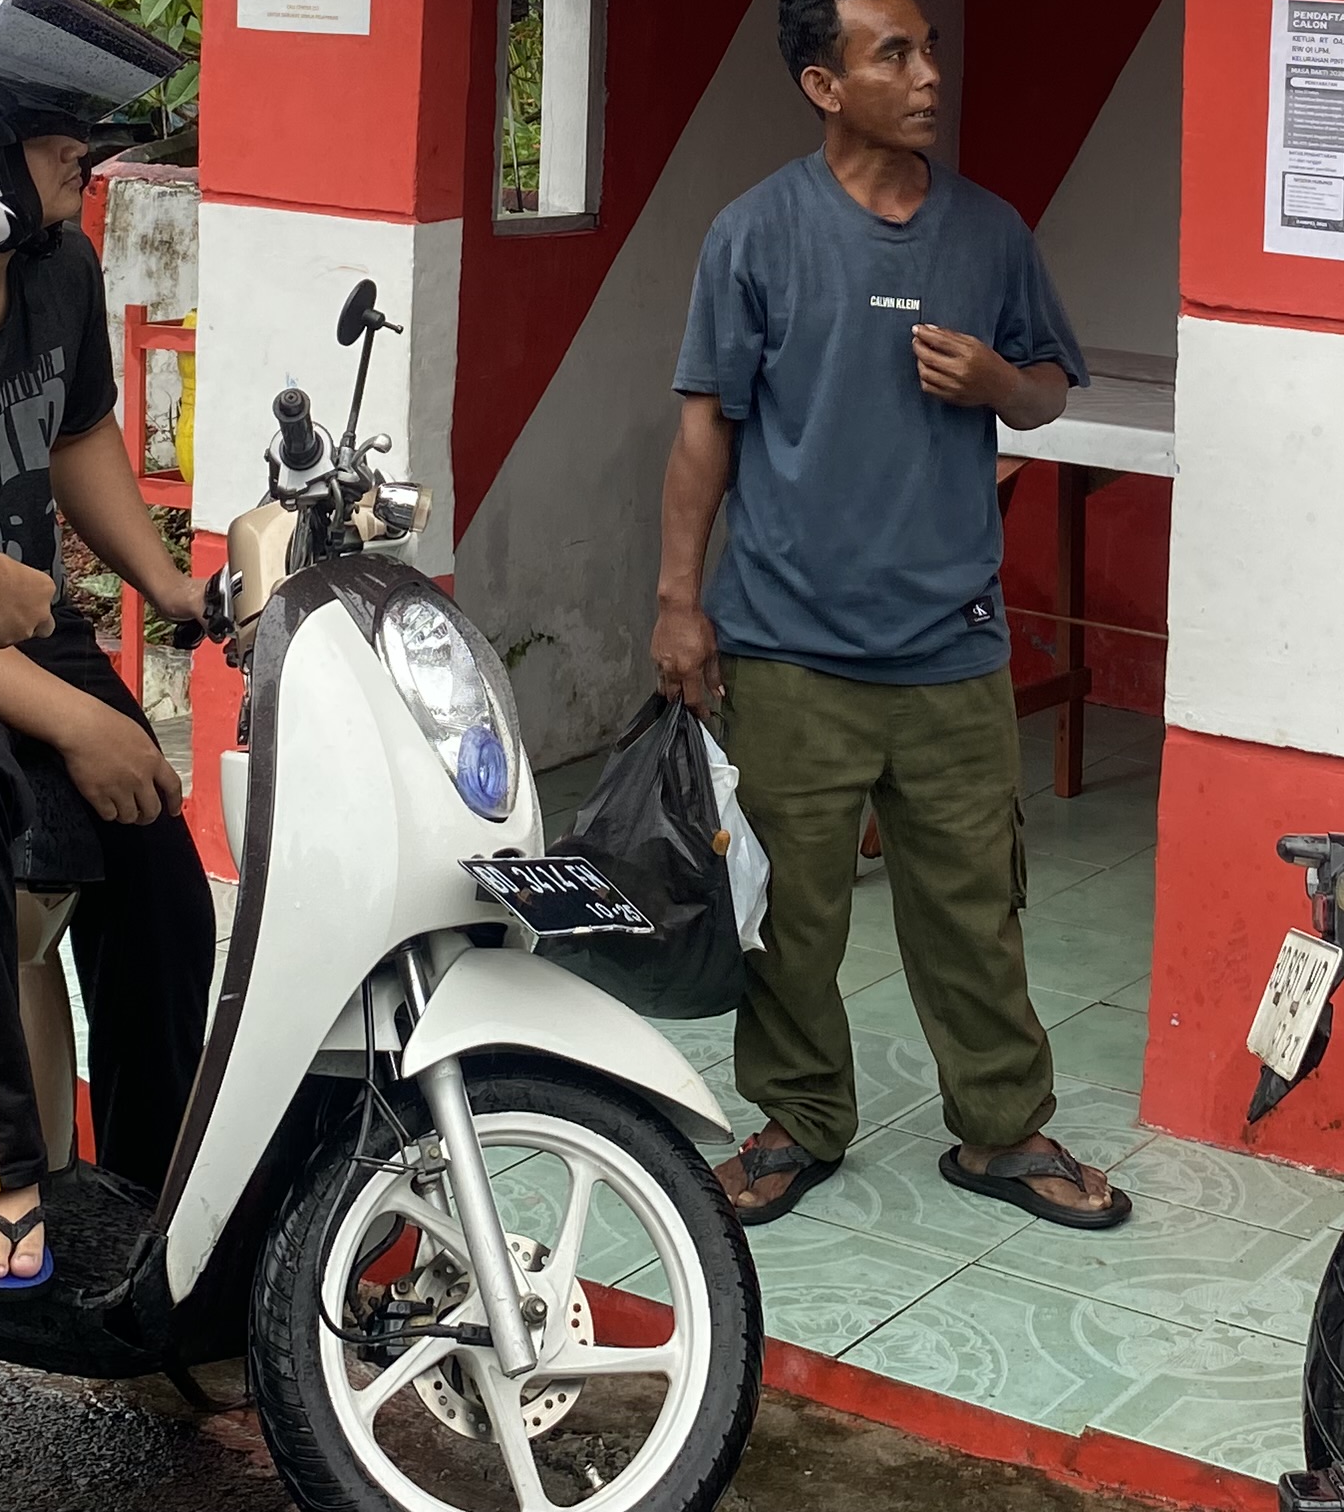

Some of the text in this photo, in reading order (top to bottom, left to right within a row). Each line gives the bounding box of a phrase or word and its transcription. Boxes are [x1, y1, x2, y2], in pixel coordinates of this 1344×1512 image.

[1292, 19, 1329, 30] CALON
[1292, 35, 1316, 43] KETUA
[869, 295, 921, 311] CALVIN KLEIN
[472, 864, 520, 894] BD
[511, 864, 579, 894] 3414
